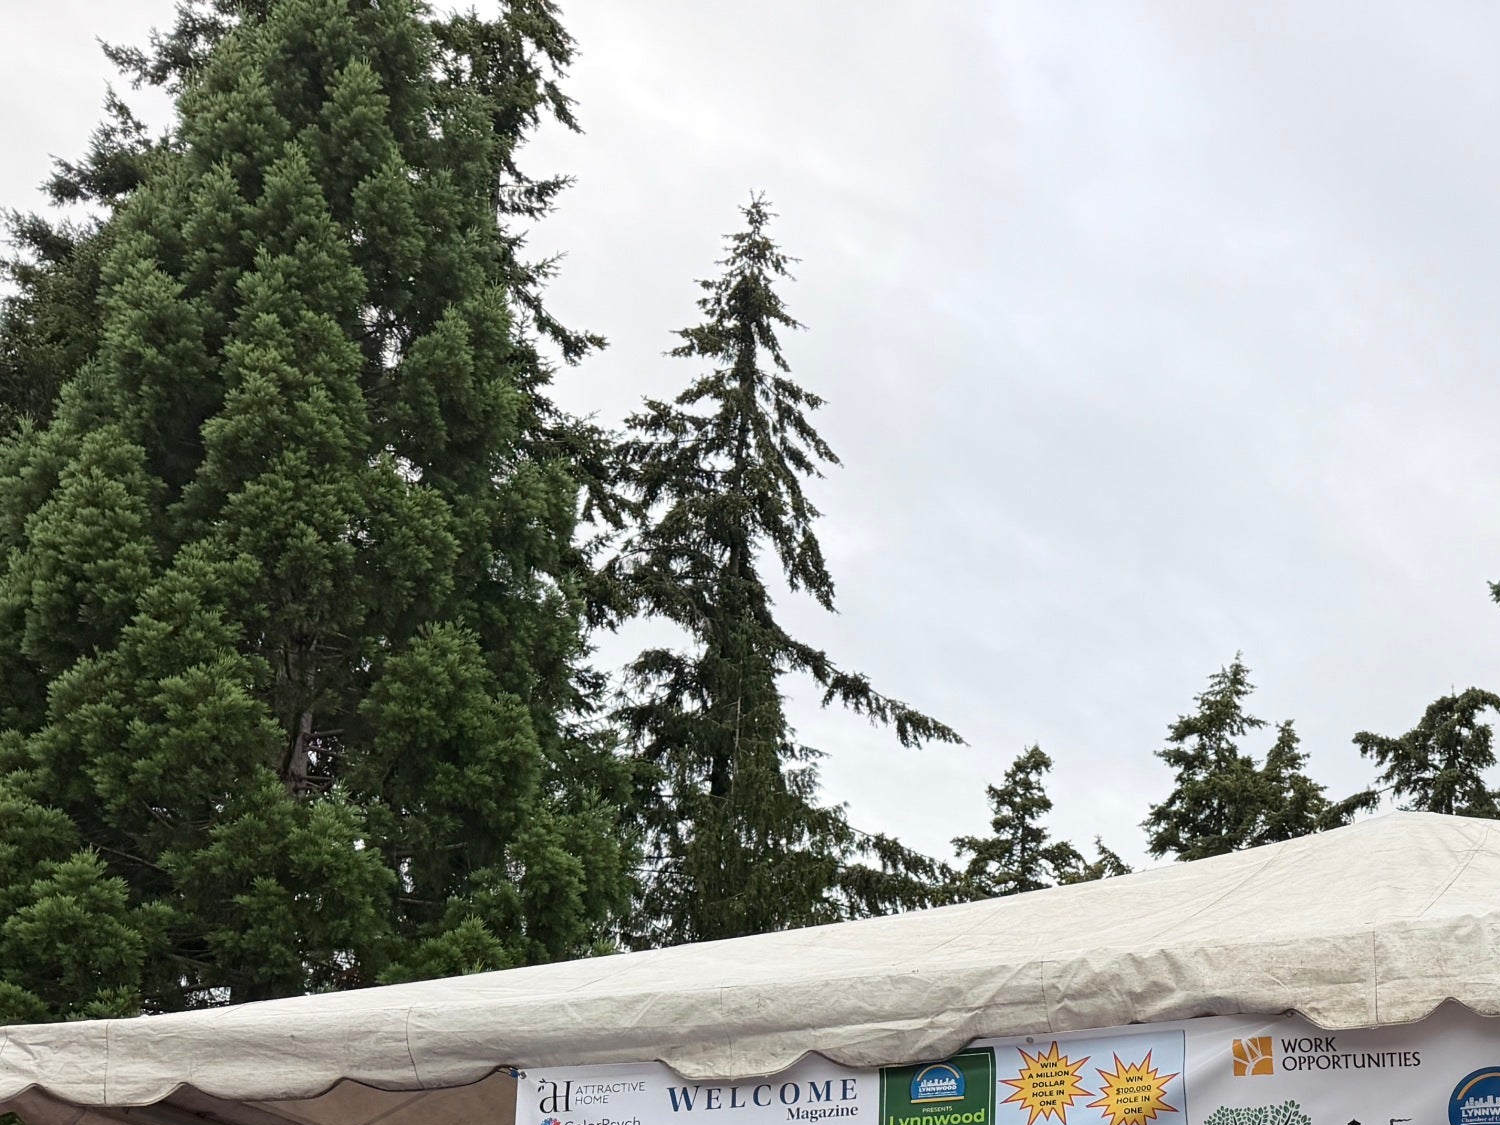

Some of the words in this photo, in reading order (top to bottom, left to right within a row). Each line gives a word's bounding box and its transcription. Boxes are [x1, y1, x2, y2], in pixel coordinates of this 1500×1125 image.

[1280, 1036, 1337, 1053] WORK
[1282, 1051, 1422, 1072] OPPORTUNITIES
[1036, 1070, 1070, 1078] MILLION
[575, 1081, 646, 1095] ATTRACTIVE
[1032, 1080, 1065, 1089] DOLLAR
[667, 1078, 858, 1112] WELCOME
[1032, 1090, 1054, 1098] HOLE
[1115, 1085, 1152, 1095] $100,000
[575, 1094, 609, 1105] HOME
[1116, 1096, 1139, 1104] HOLE
[786, 1105, 859, 1122] Magazine
[1123, 1107, 1144, 1115] ONE
